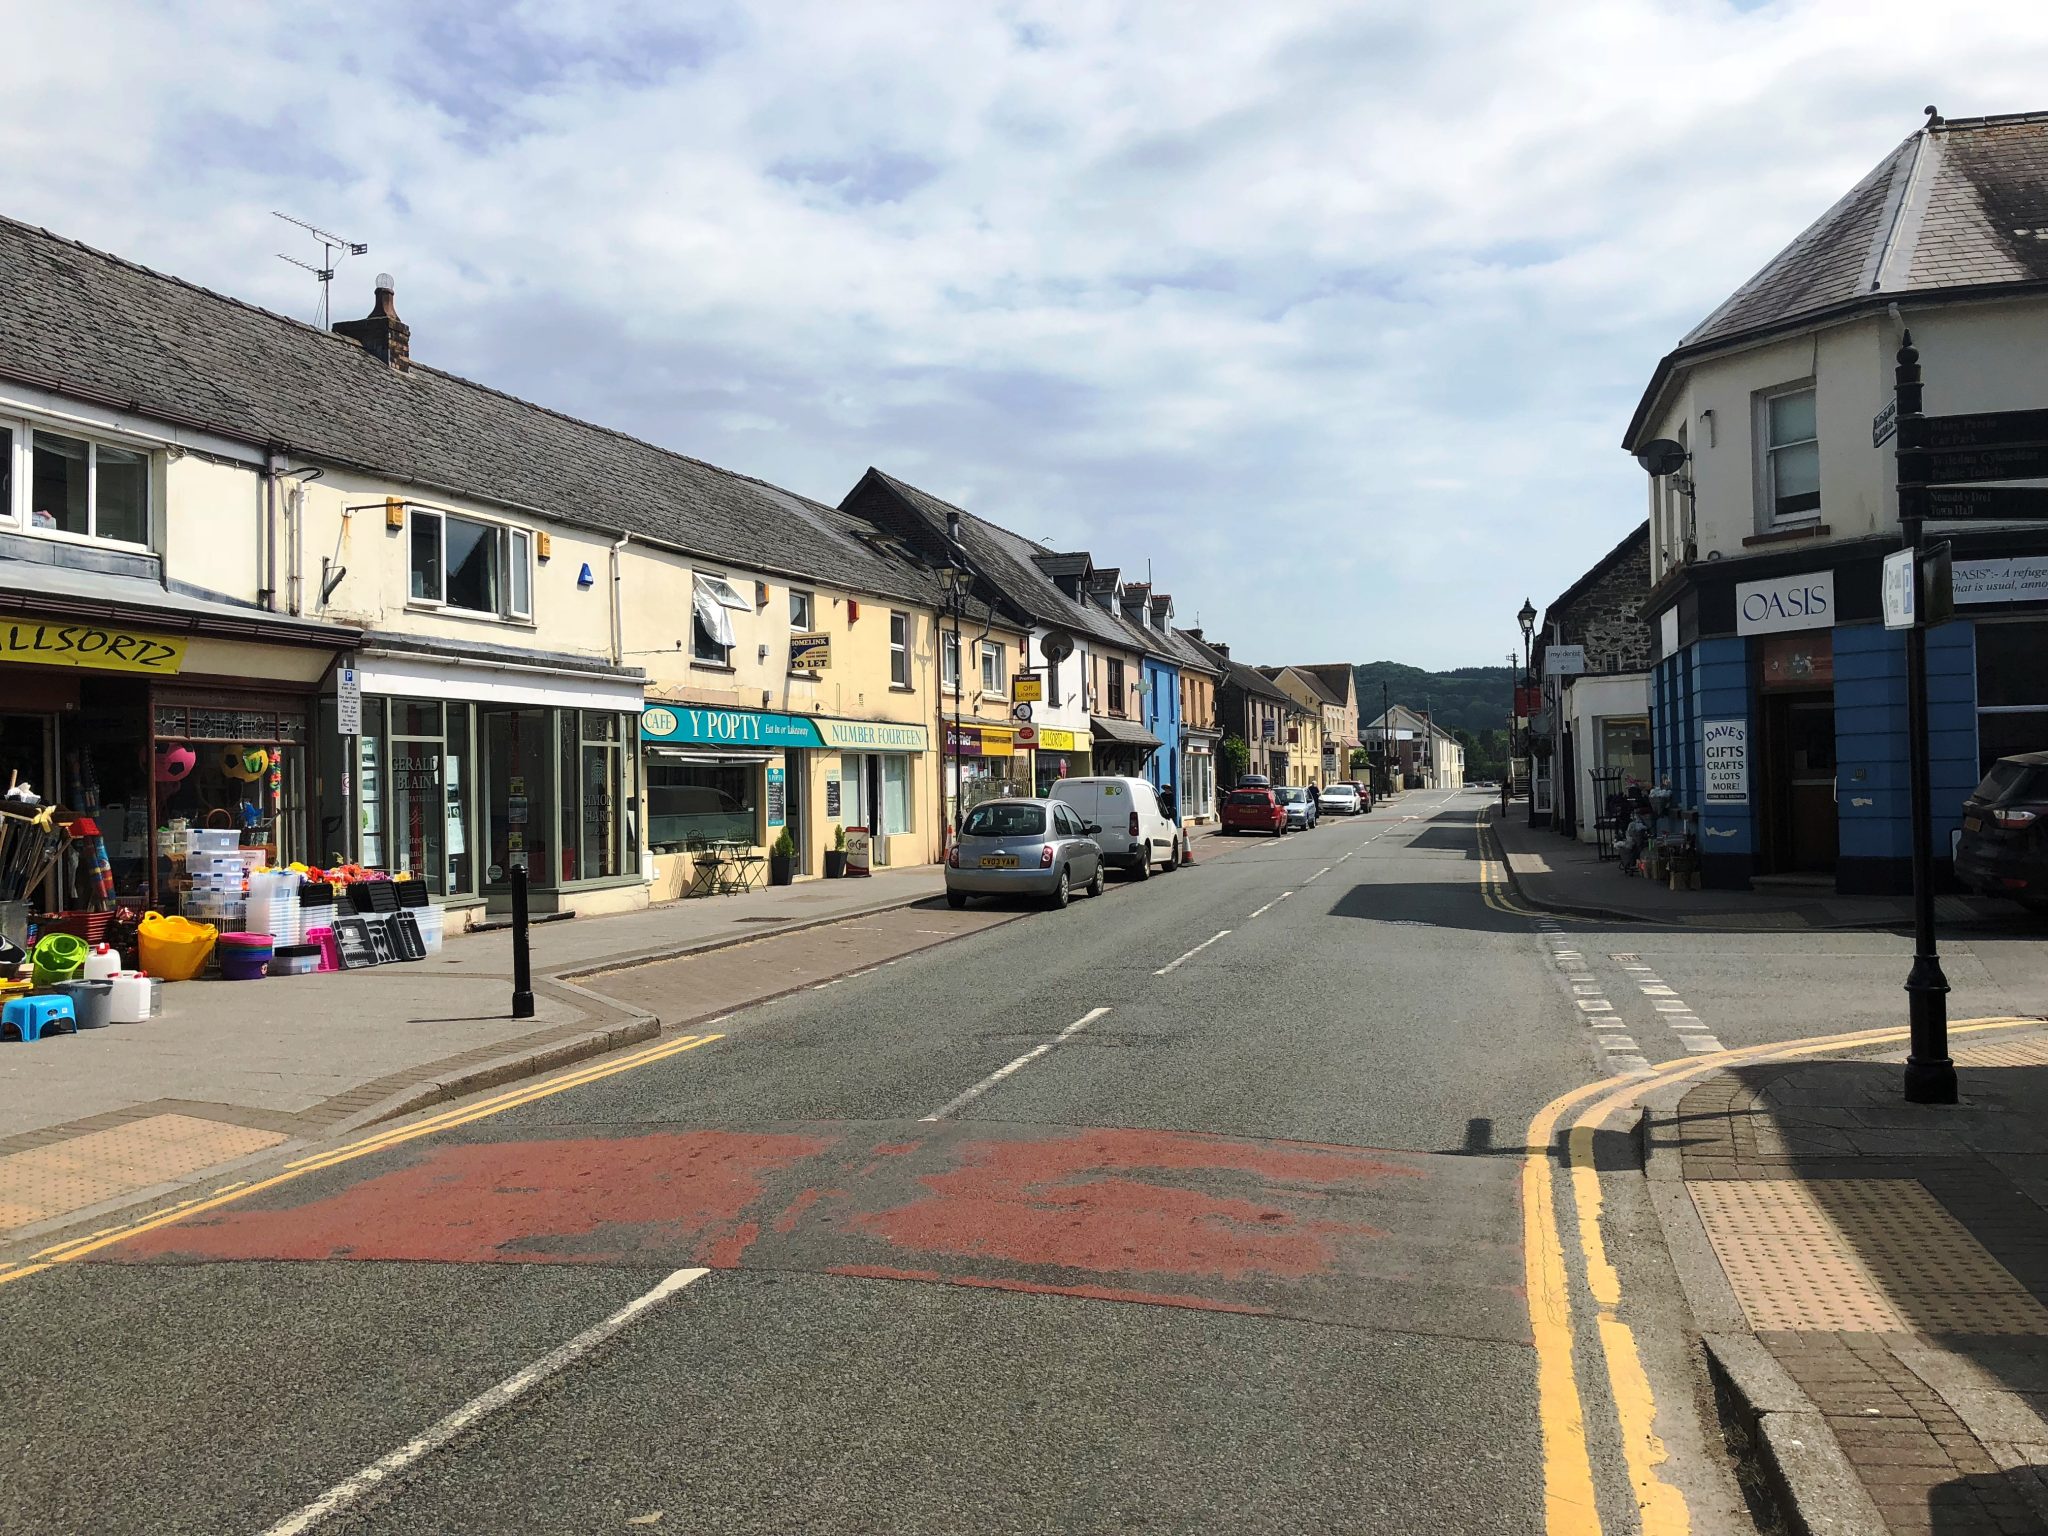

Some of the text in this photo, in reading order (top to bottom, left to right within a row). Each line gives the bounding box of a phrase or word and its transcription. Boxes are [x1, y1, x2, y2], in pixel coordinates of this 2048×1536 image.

[1930, 504, 1974, 515] Town Hall
[2002, 568, 2010, 578] A
[2013, 566, 2048, 579] refuge
[1952, 581, 2048, 593] hat is usual, anno
[1743, 585, 1827, 622] OASIS
[0, 626, 176, 666] LLSORTZ
[807, 659, 827, 668] LET
[1022, 684, 1033, 692] Off
[645, 713, 672, 730] CAFE
[689, 710, 761, 740] Y POPTY
[832, 724, 922, 745] NUMBER FOURTEEN
[1705, 725, 1745, 741] DAVE'S
[1706, 746, 1744, 758] GIFTS
[392, 757, 438, 771] GERALD
[1706, 760, 1744, 770] CRAFTS
[397, 775, 433, 790] BLAIN
[1711, 772, 1741, 780] & LOTS
